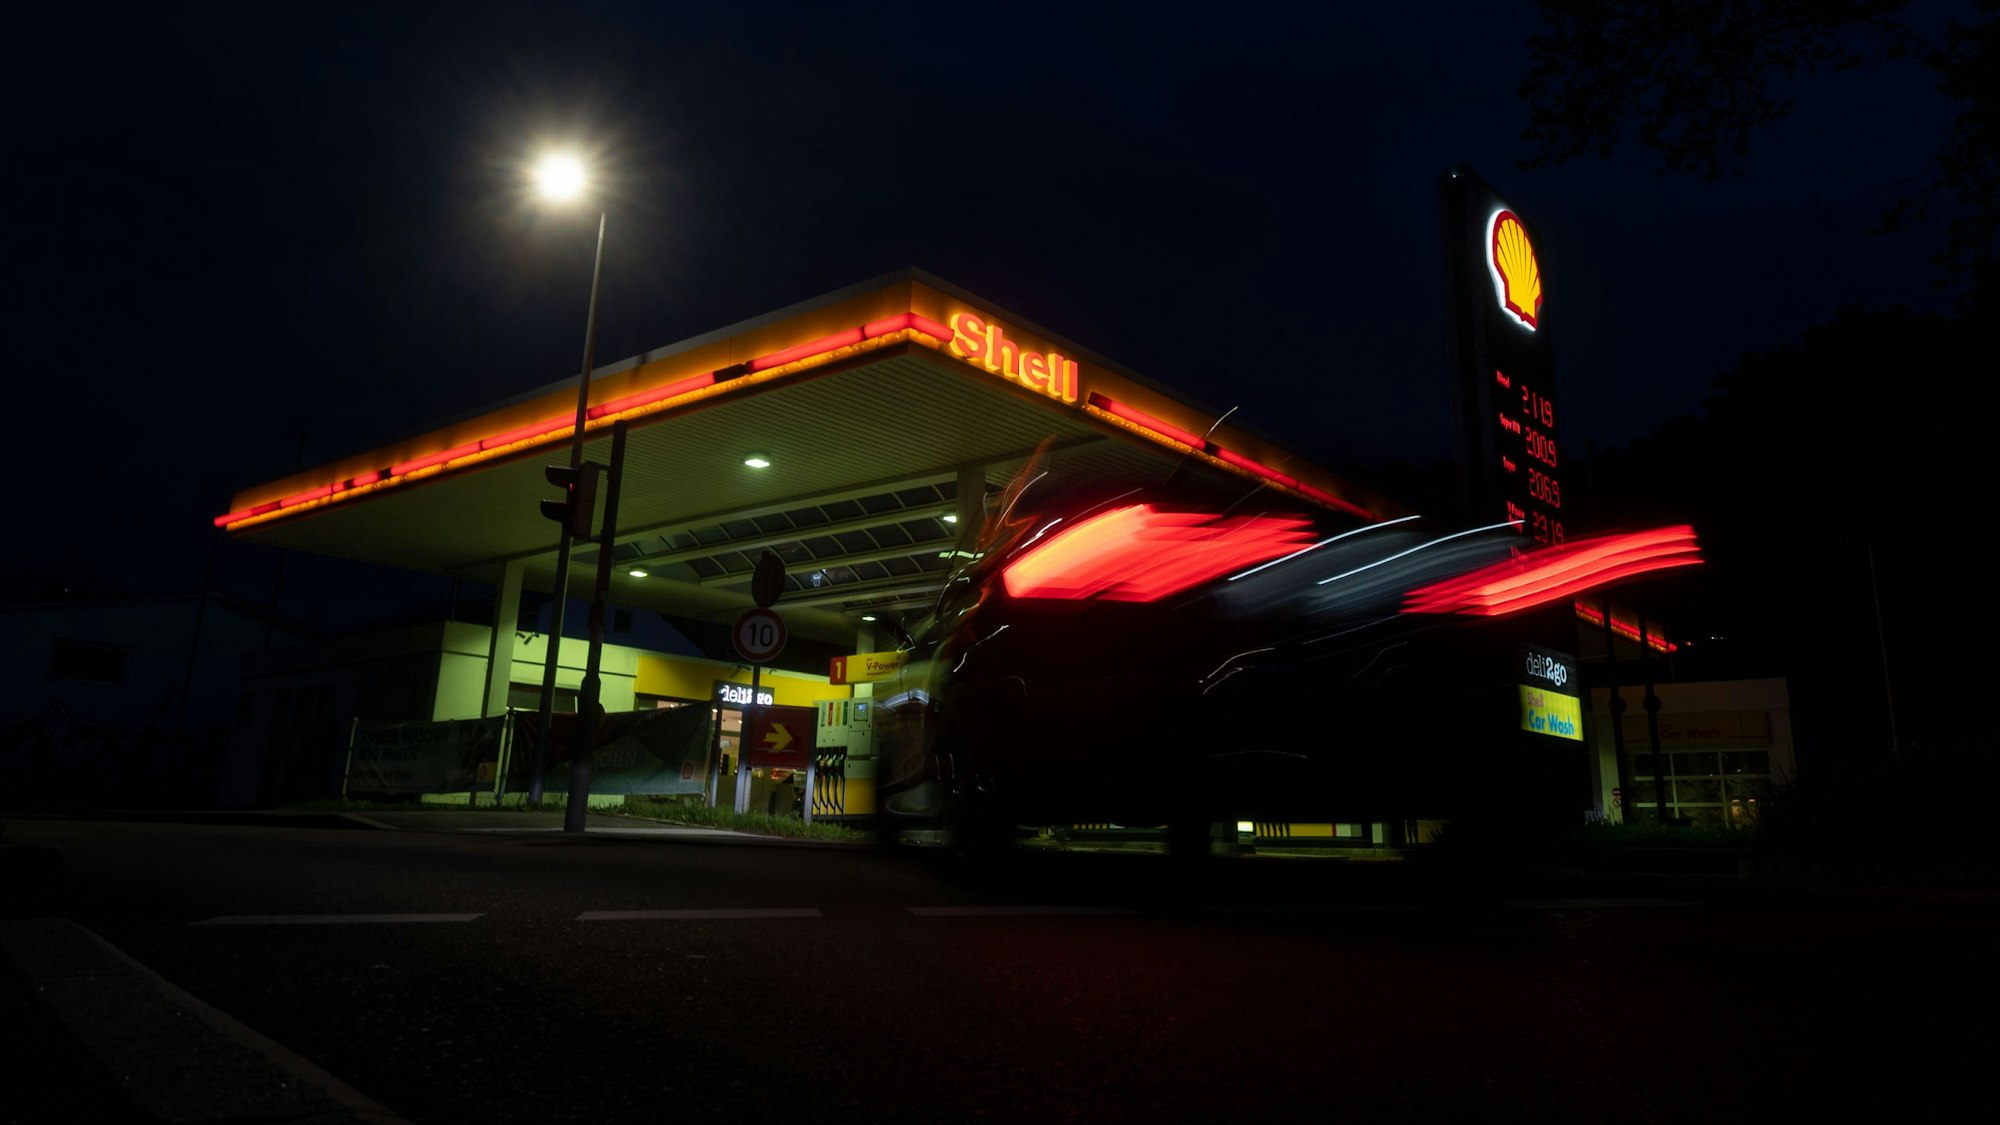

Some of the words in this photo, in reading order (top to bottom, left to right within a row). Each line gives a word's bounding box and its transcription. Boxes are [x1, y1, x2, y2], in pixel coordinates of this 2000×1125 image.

[949, 311, 1078, 402] Shell
[749, 623, 774, 648] 10
[836, 661, 842, 680] 1
[866, 661, 899, 671] V-Power
[1526, 652, 1568, 687] deli2go
[1527, 691, 1545, 709] Shell
[1528, 709, 1546, 730] Car
[1547, 712, 1575, 736] Wash
